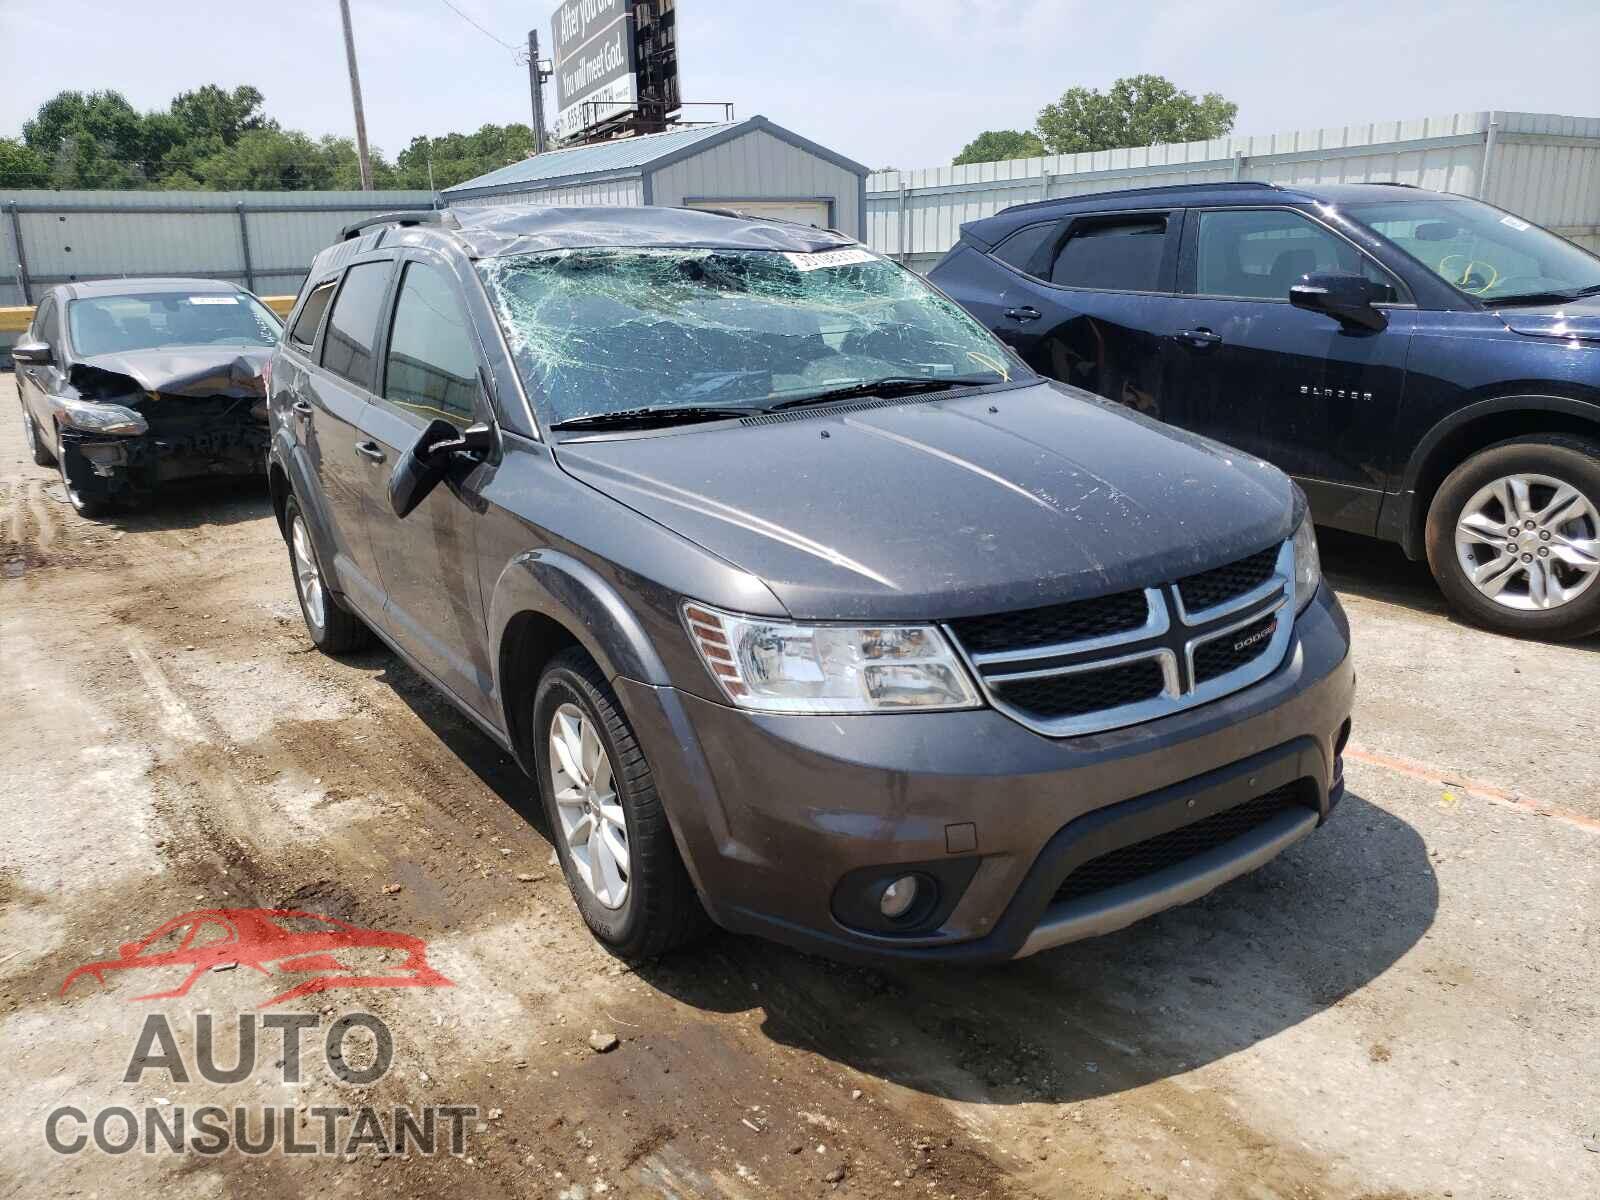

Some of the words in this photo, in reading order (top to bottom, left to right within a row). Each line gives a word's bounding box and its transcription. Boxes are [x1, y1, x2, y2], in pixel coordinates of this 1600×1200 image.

[561, 4, 579, 45] After
[579, 0, 597, 39] you
[562, 71, 574, 100] You
[574, 56, 587, 92] will
[586, 47, 605, 85] meet
[604, 31, 624, 72] God.
[1299, 385, 1373, 401] BLAZER
